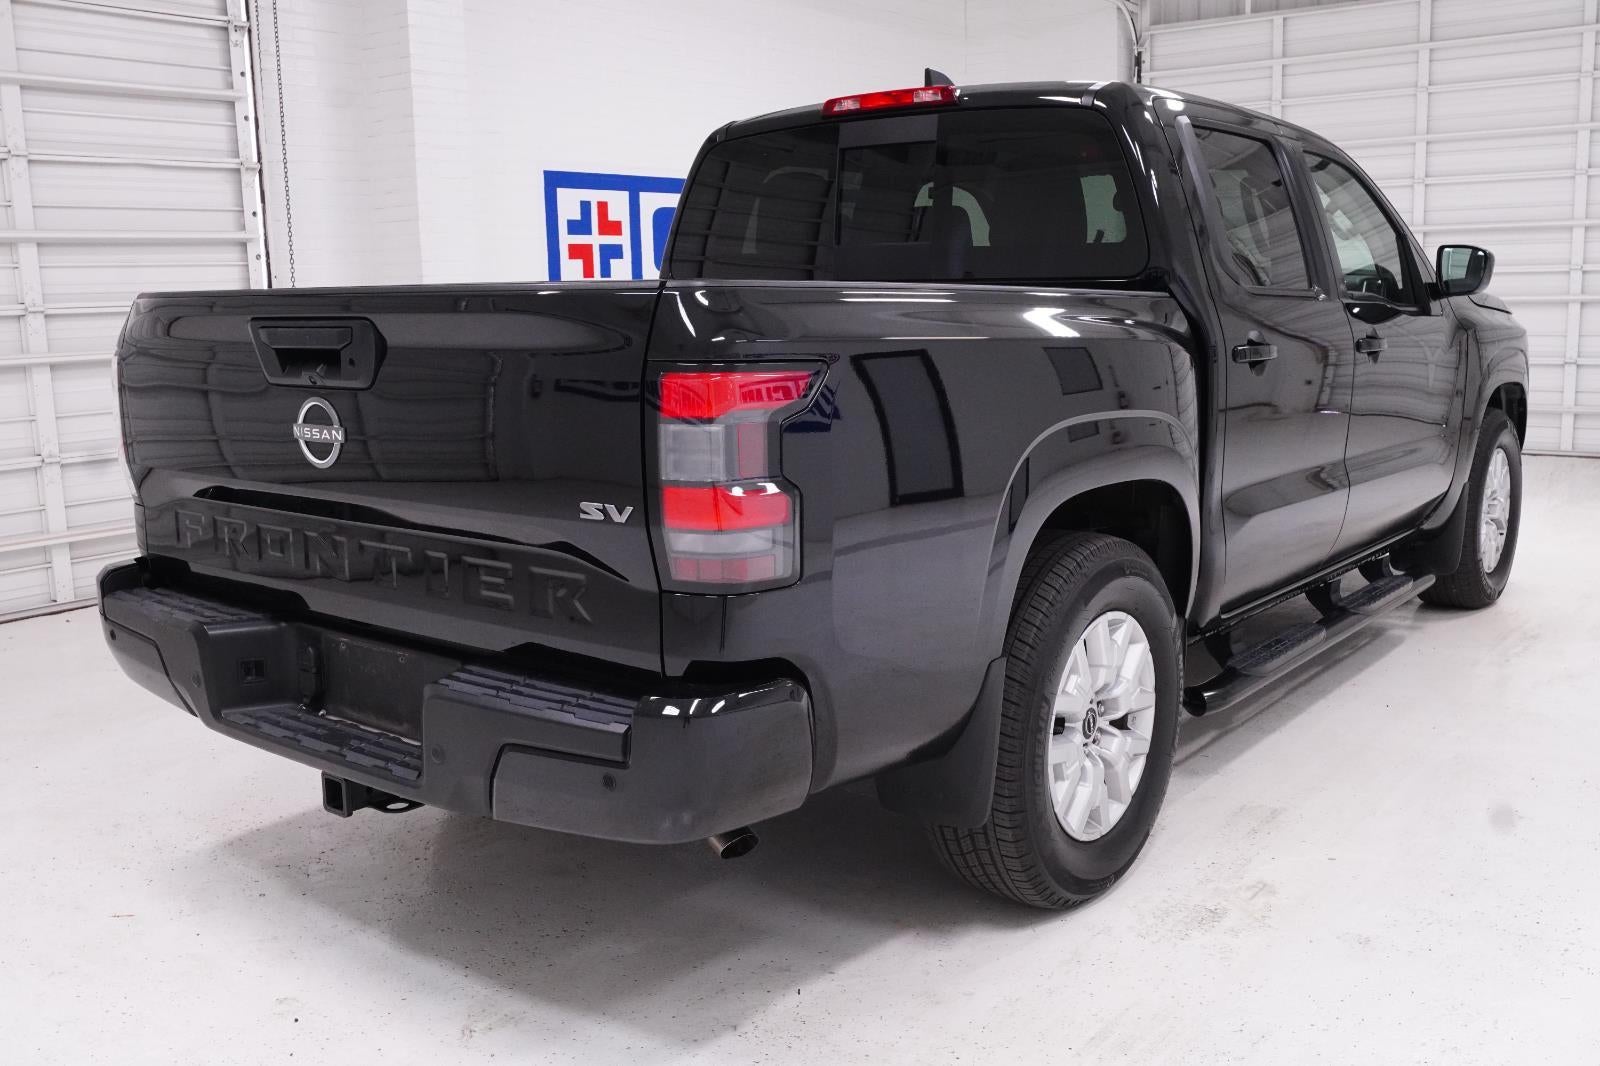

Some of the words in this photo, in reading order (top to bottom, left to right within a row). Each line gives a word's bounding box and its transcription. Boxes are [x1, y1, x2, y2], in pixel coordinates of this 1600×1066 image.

[293, 425, 343, 441] NISSAN
[579, 501, 634, 524] SV
[174, 508, 593, 625] FRONTIER
